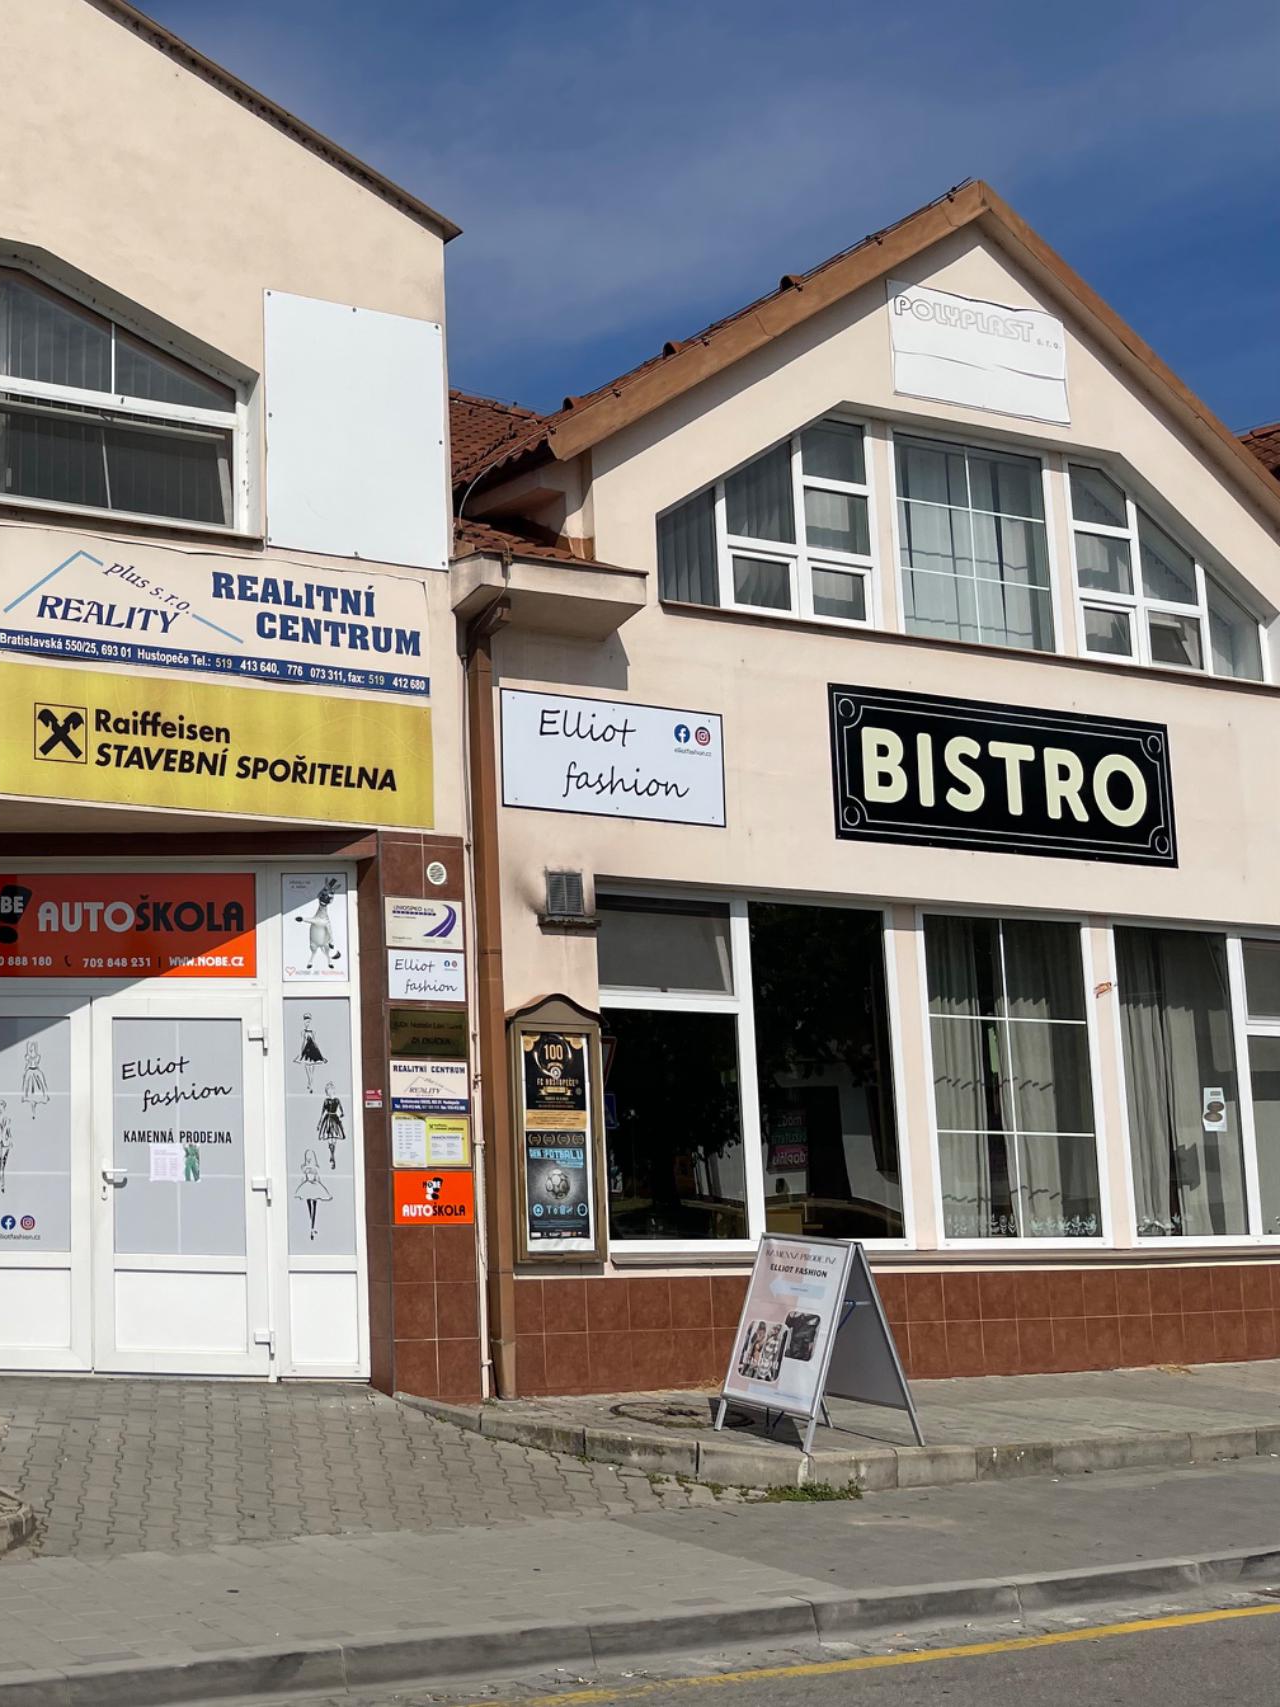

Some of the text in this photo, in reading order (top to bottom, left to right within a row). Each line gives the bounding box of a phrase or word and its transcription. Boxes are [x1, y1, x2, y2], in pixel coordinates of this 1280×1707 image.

[893, 294, 1034, 343] POLYPLAST
[102, 562, 190, 615] plus s.r.o.
[211, 571, 376, 618] REALITNÍ
[36, 594, 180, 634] REALITY
[256, 611, 421, 657] CENTRUM
[0, 632, 426, 690] Bratislavská 550/25, 693 01 Hustopeče Tel.: 519 413 640, 776 073 311, fax: 519 412 680
[94, 709, 231, 744] Raiffeisen
[539, 709, 636, 747] Elliot
[95, 743, 398, 792] STAVEBNÍ SPOŘITELNA
[562, 761, 690, 798] fashion
[861, 726, 1147, 827] BISTRO
[37, 894, 244, 933] AUTOŠKOLA
[7, 956, 29, 967] 888
[31, 956, 52, 967] 180
[82, 957, 104, 969] 702
[107, 957, 128, 969] 848
[130, 957, 151, 969] 231
[169, 955, 245, 967] WWW.NOBE.CZ
[395, 958, 435, 973] Elliot
[404, 979, 458, 994] fashion
[122, 1056, 190, 1080] Elliot
[544, 1044, 564, 1060] 100
[142, 1083, 232, 1112] fashion
[123, 1128, 232, 1144] KAMENNÁ PRODEJNA
[402, 1203, 466, 1217] AUTOŠKOLA
[770, 1263, 827, 1278] ELLIOT FASHION
